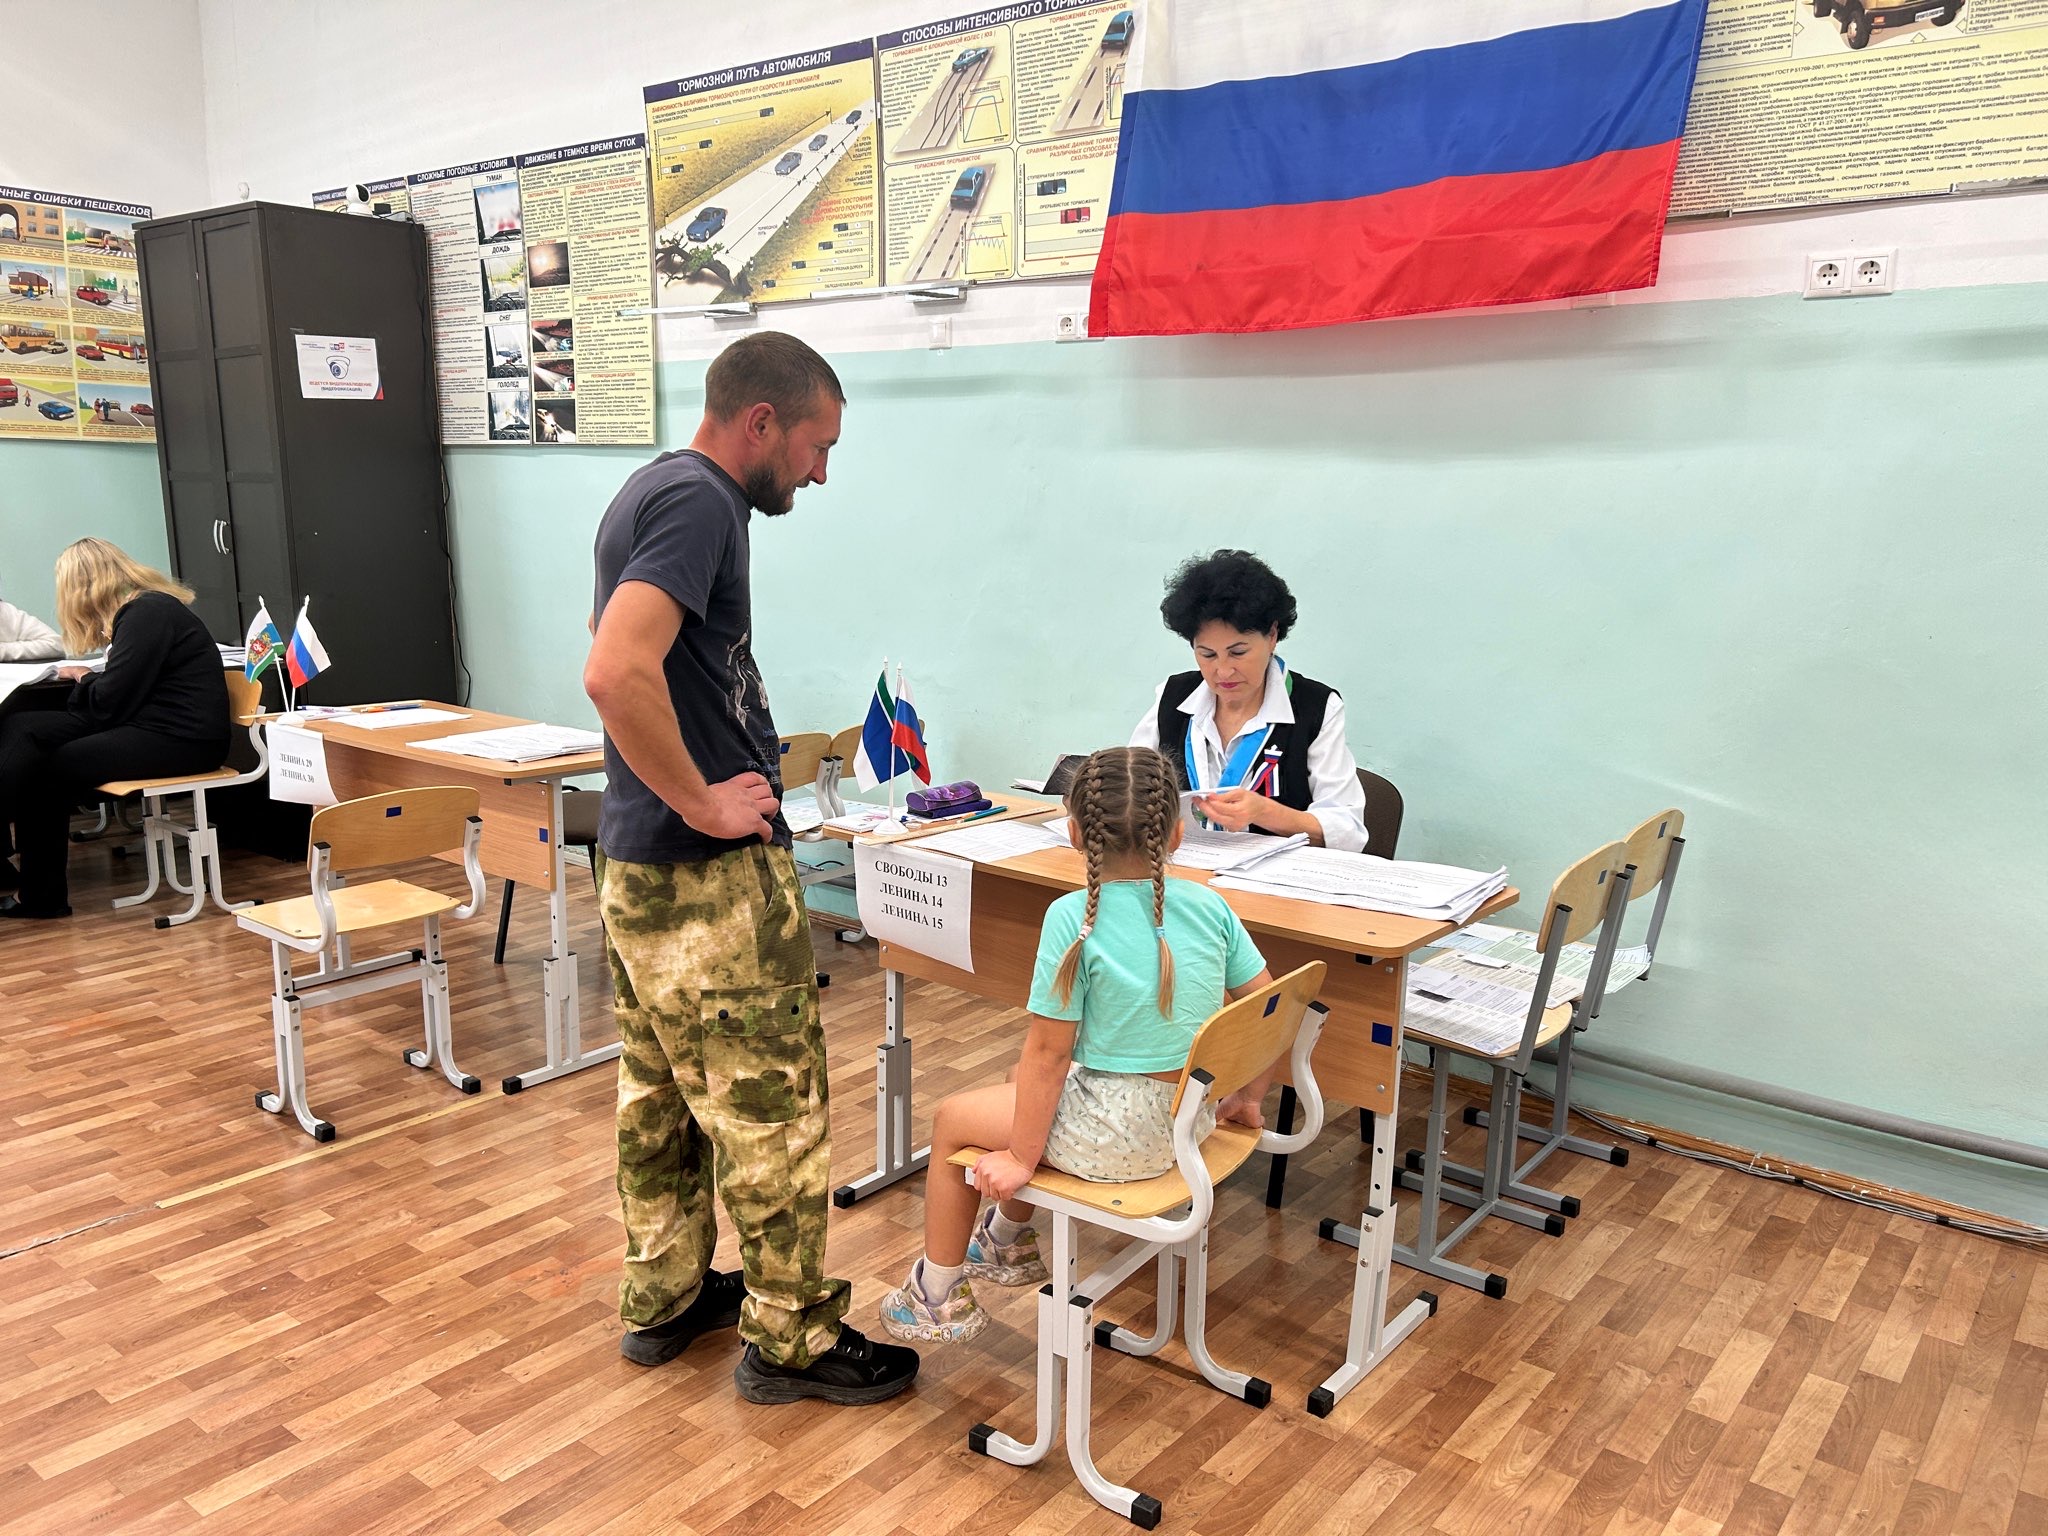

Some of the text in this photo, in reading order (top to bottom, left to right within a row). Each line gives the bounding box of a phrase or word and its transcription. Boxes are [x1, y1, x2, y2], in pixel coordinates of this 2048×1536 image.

[901, 0, 1084, 44] СПОСОБЫ ИНТЕНСИВНОГО ТОРМ
[1050, 2, 1127, 24] ТОРМОЖЕНИЕ СТУПЕНЧАТОЕ
[892, 46, 922, 58] ТОРМОЖЕНИЕ
[677, 50, 831, 93] ТОРМОЗНОЙ ПУТЬ АВТОМОБИЛЯ
[524, 137, 636, 166] ДВИЖЕНИЕ В ТЕМНОЕ ВРЕМЯ СУТОК
[417, 156, 508, 183] СЛОЖНЫЕ ПОГОДНЫЕ УСЛОВИЯ
[486, 174, 502, 183] ТУМАН
[34, 192, 82, 206] ОШИБКИ
[84, 200, 151, 216] ПЕШЕХОДОВ
[491, 245, 510, 255] ДОЖДЬ
[497, 380, 520, 389] ГОЛОЛЕД
[874, 859, 947, 887] СВОБОДЫ 13
[879, 882, 942, 908] ЛЕНИНА 14
[881, 902, 943, 929] ЛЕНИНА 15
